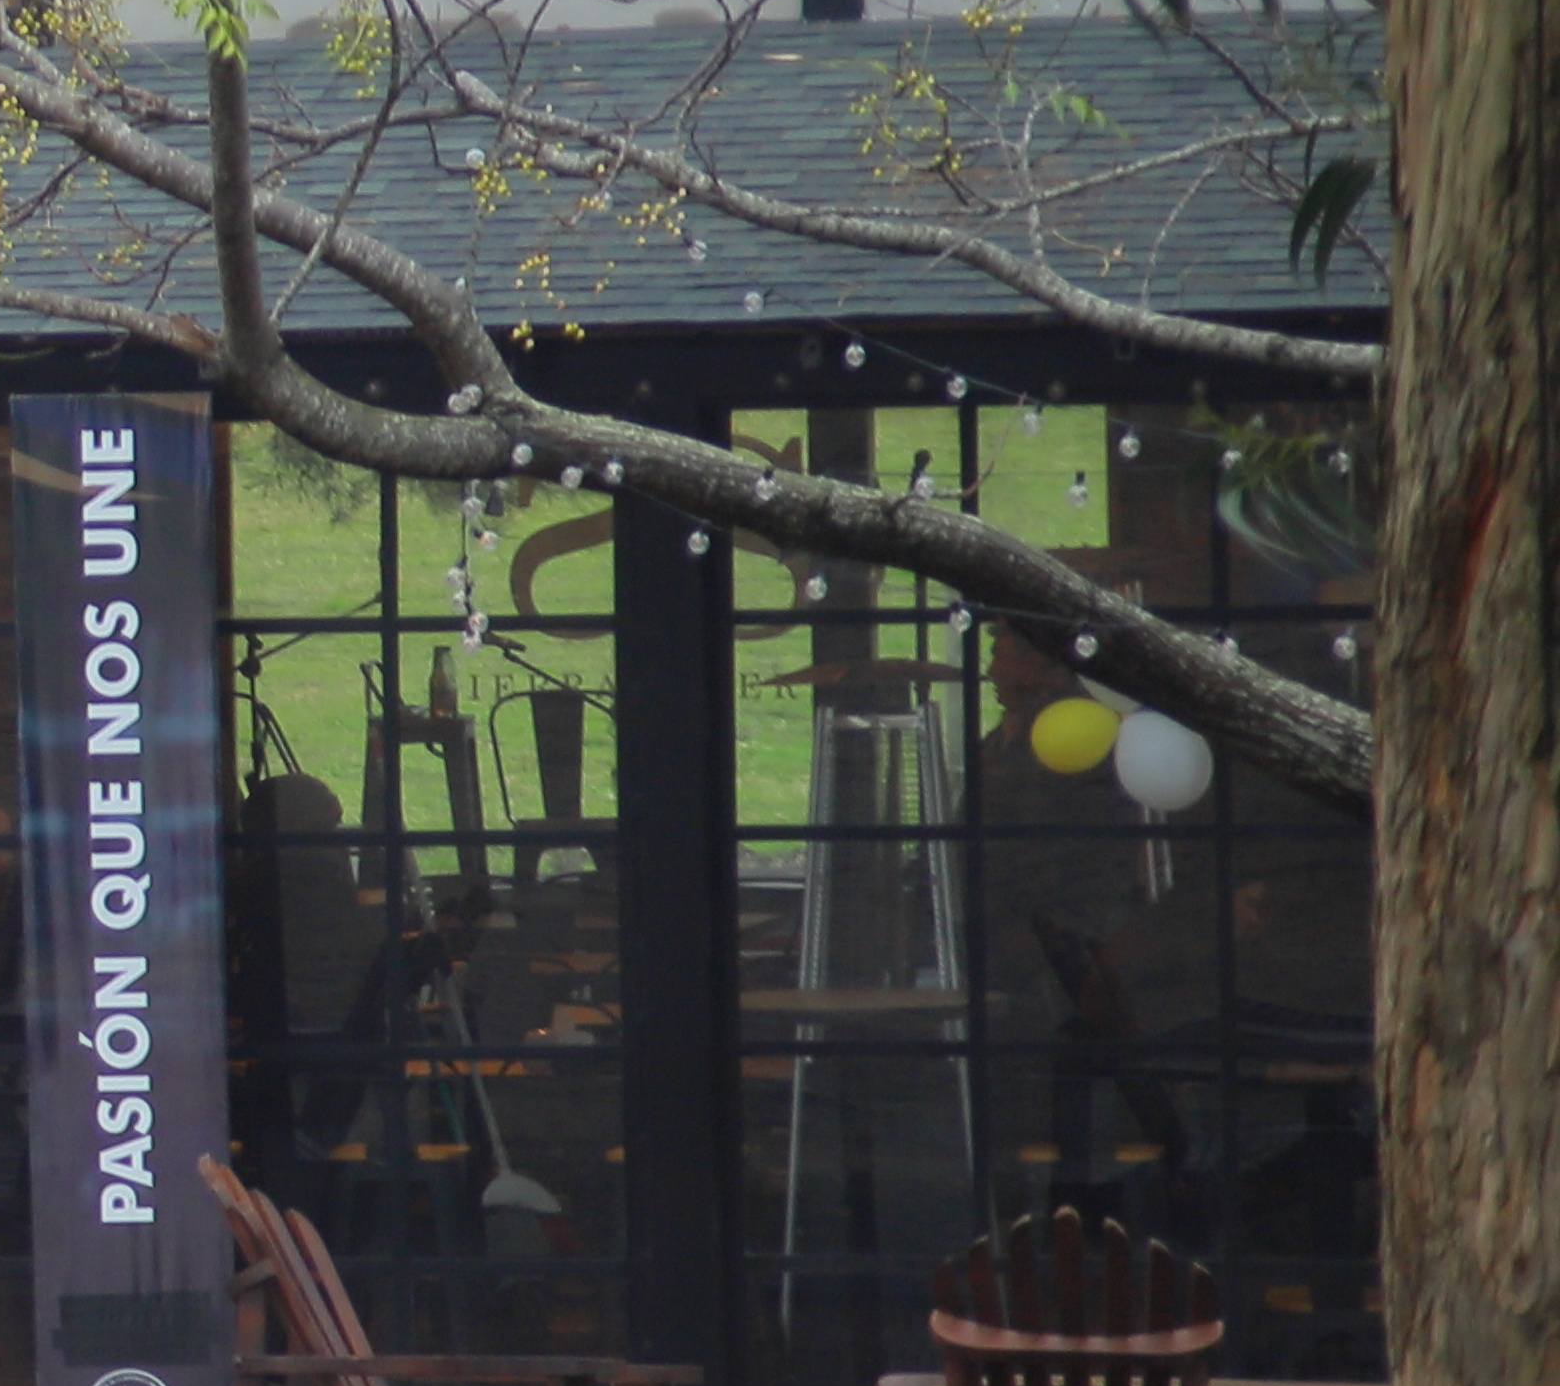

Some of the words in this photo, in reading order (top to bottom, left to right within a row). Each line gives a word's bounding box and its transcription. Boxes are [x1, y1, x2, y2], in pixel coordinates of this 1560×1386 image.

[80, 427, 137, 577] UNE
[83, 600, 142, 756] NOS
[89, 780, 151, 930] QUE
[77, 956, 155, 1224] PASIÓN
